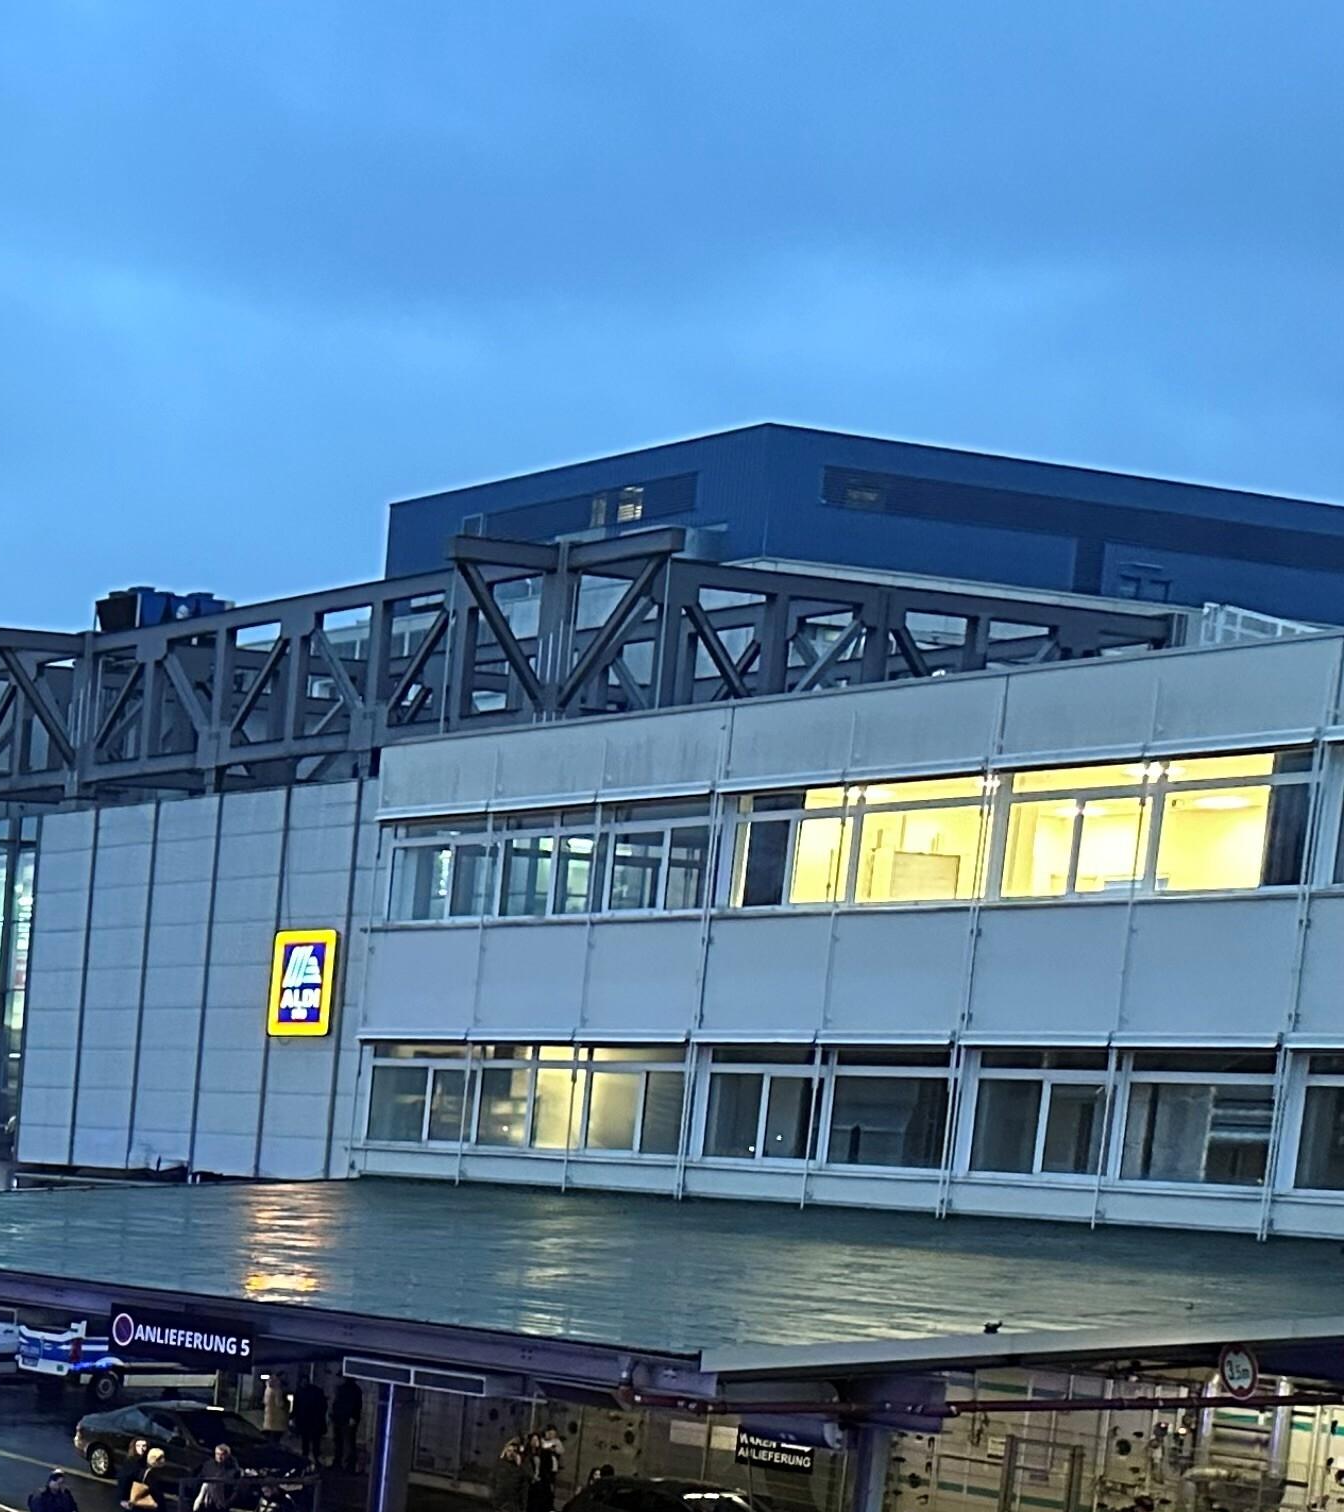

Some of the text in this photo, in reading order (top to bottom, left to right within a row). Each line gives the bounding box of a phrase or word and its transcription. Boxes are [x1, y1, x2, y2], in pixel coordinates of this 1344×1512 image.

[280, 988, 321, 1009] ALDI
[134, 1323, 250, 1356] ANLIEFERUNG 5
